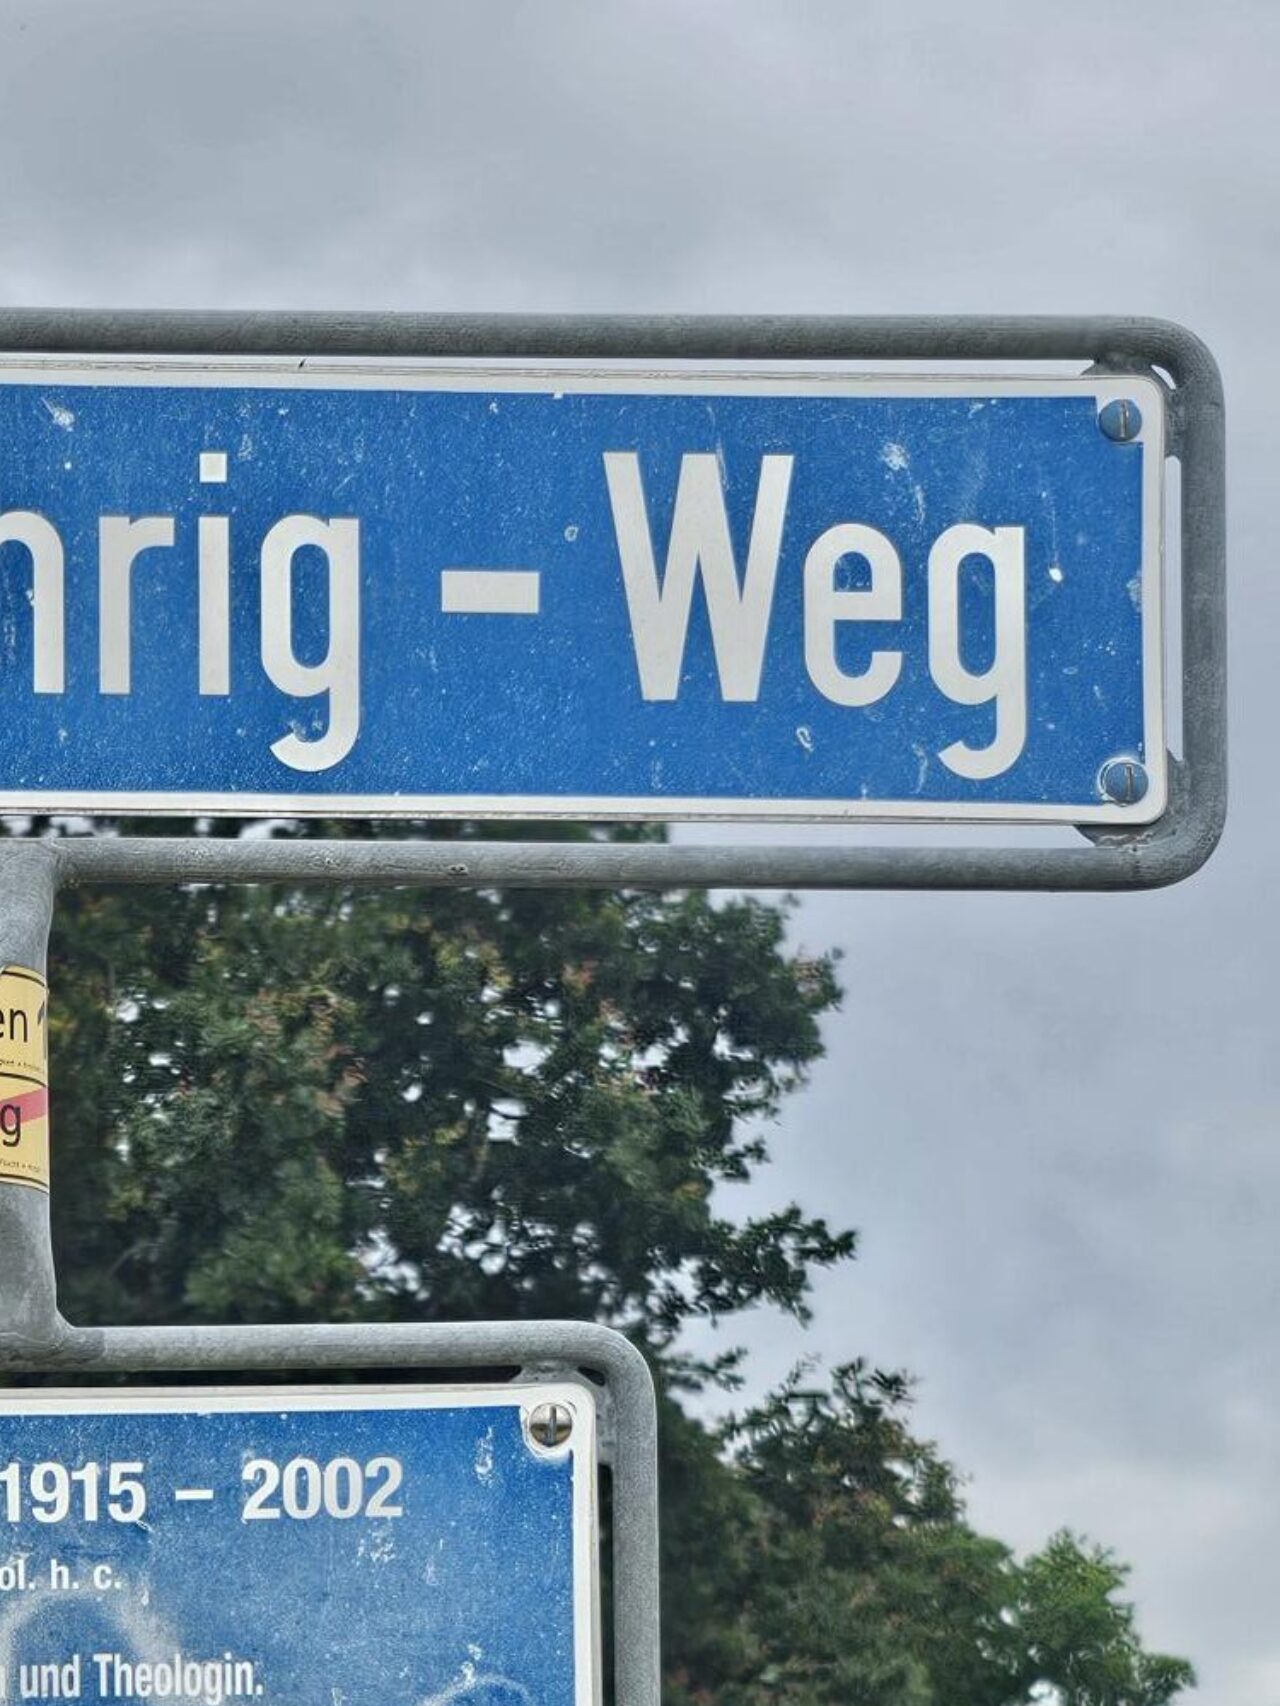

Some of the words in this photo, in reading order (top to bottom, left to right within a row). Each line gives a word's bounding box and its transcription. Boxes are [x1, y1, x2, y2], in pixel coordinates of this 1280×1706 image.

[602, 451, 1027, 780] Weg
[241, 1456, 404, 1521] 2002
[50, 1559, 81, 1591] h.
[93, 1563, 123, 1591] c.
[20, 1653, 82, 1698] und
[93, 1652, 265, 1705] Theologin.
